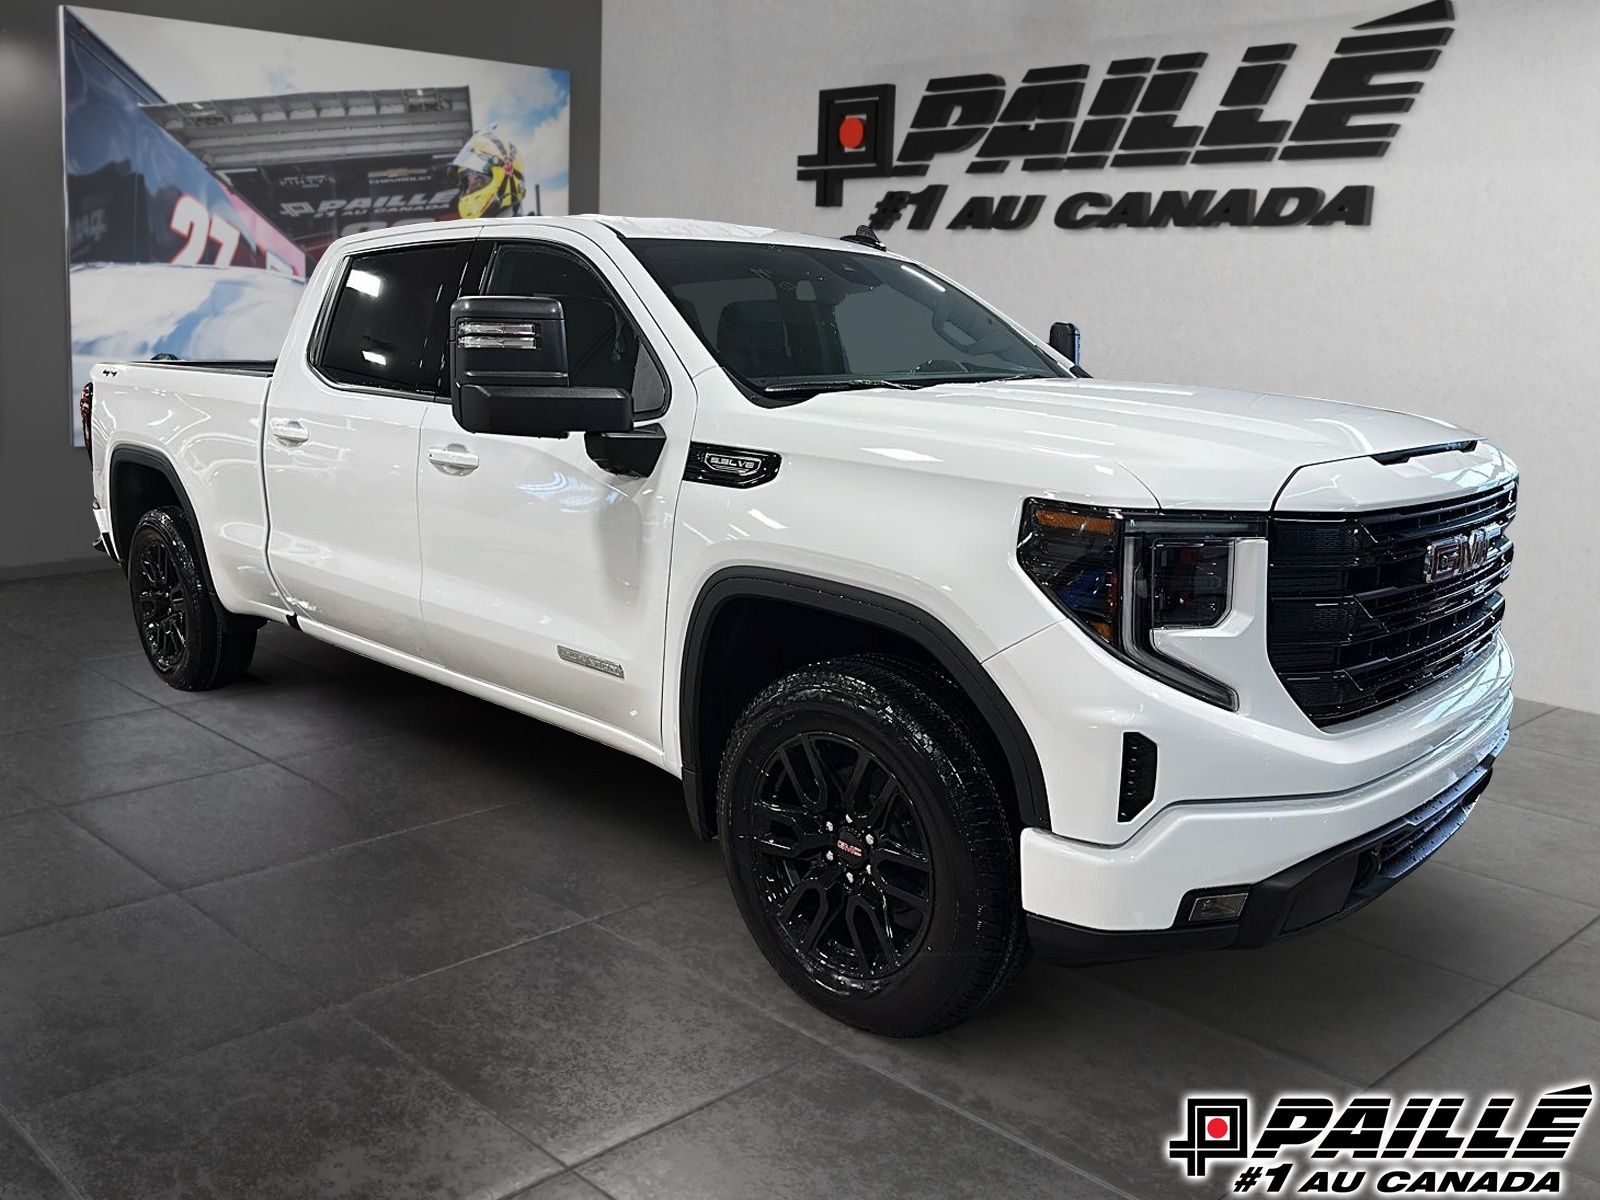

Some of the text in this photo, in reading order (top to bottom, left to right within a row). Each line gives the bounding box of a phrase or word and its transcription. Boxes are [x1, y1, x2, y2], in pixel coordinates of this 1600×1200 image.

[891, 0, 1455, 176] PAILLÉ
[373, 203, 449, 214] CANADA
[867, 184, 1374, 231] #1 AU CANADA
[1424, 523, 1501, 583] GMC
